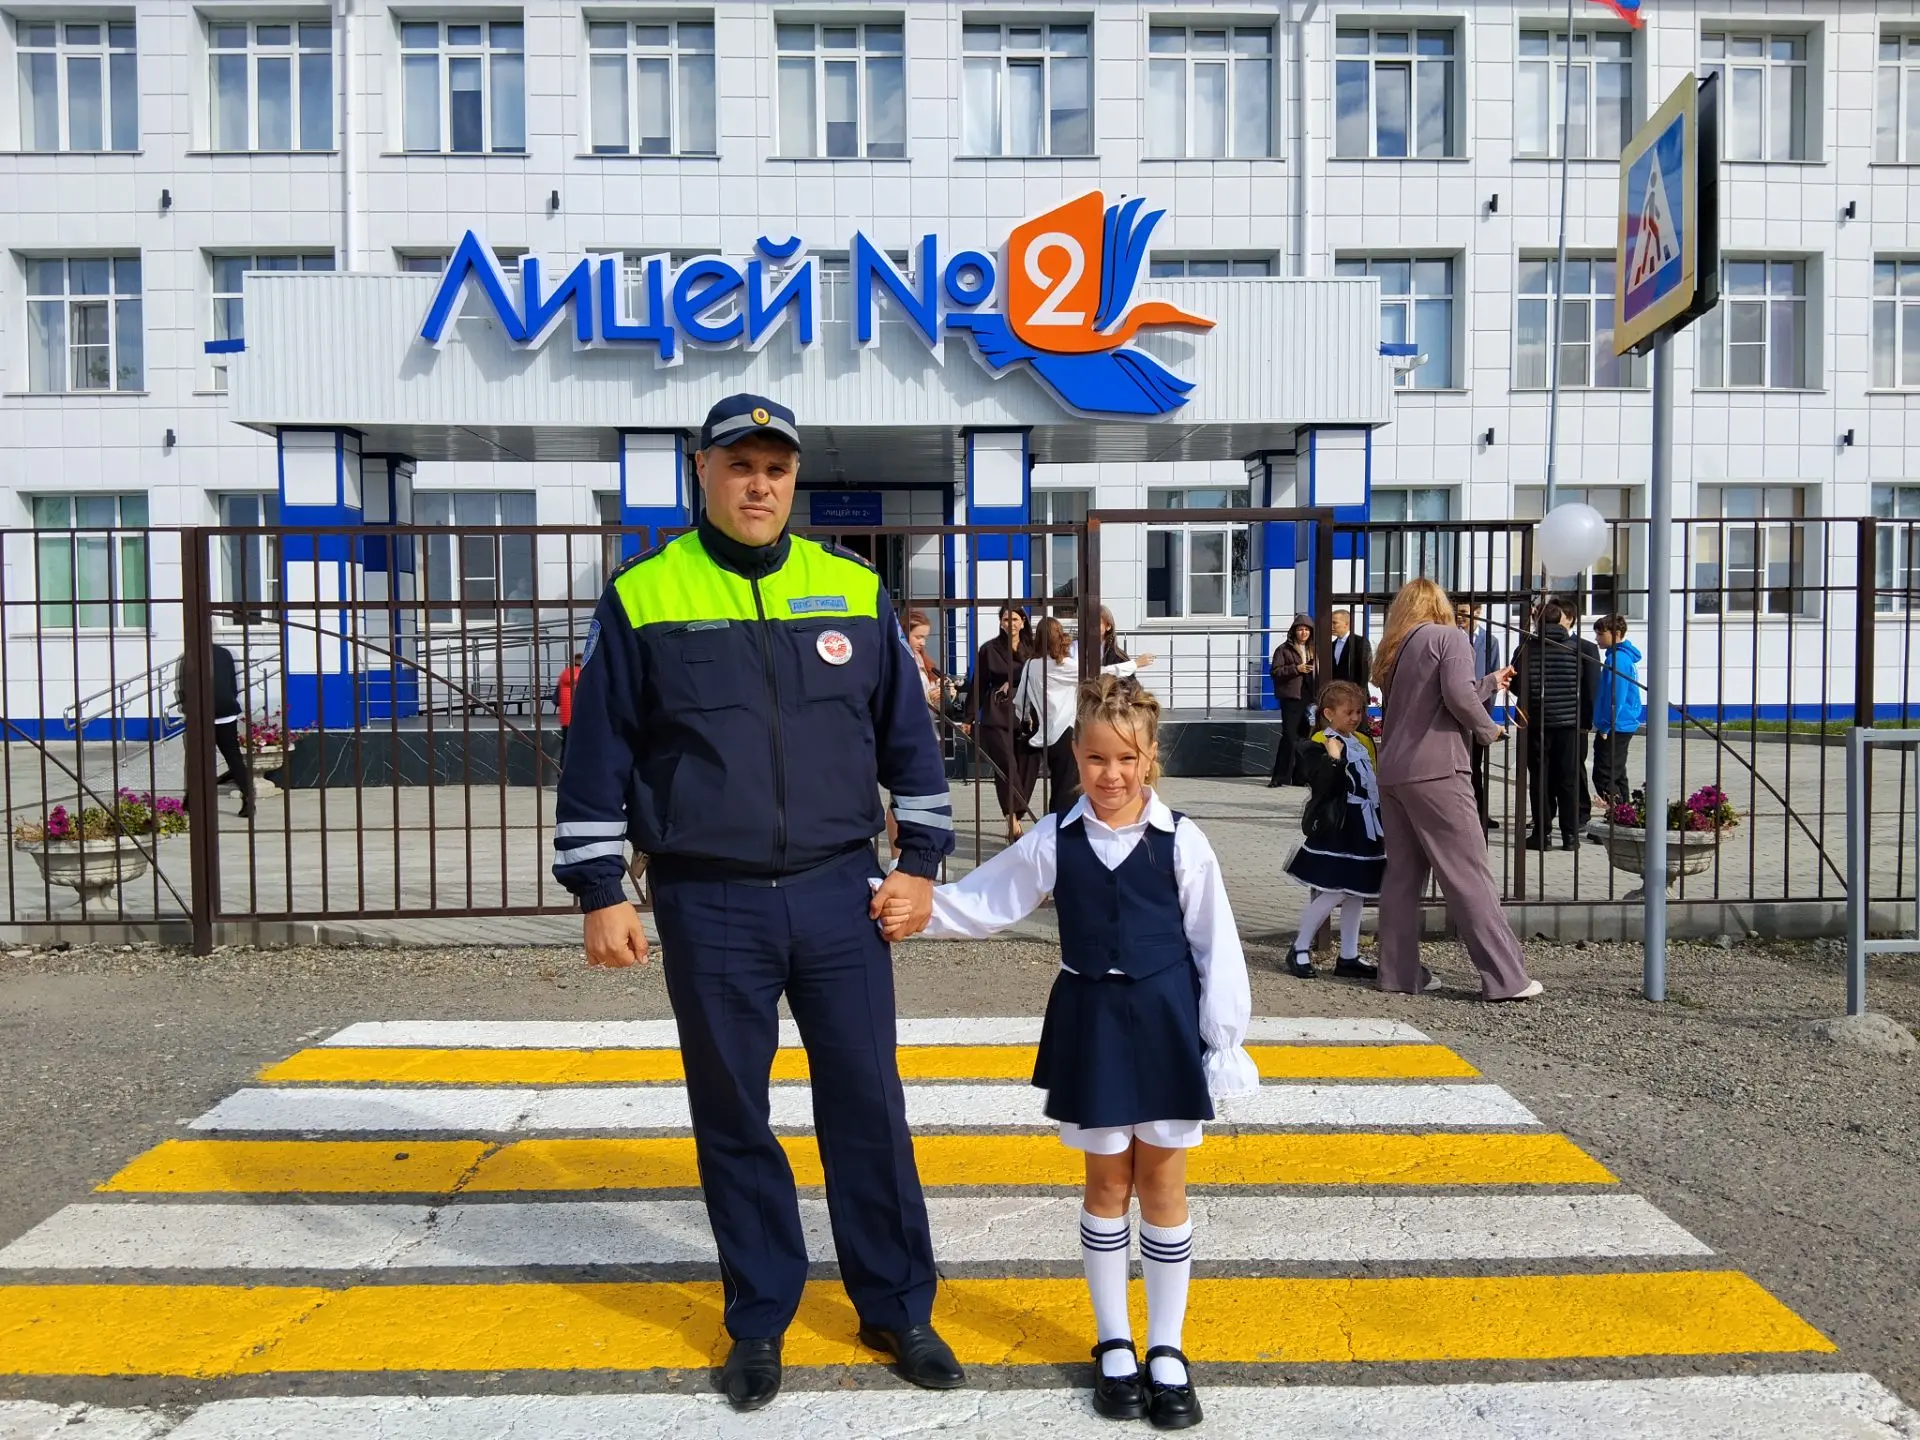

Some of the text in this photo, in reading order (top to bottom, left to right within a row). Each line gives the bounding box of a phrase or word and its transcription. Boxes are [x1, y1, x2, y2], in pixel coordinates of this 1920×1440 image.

[421, 229, 1087, 360] Лицей № 2
